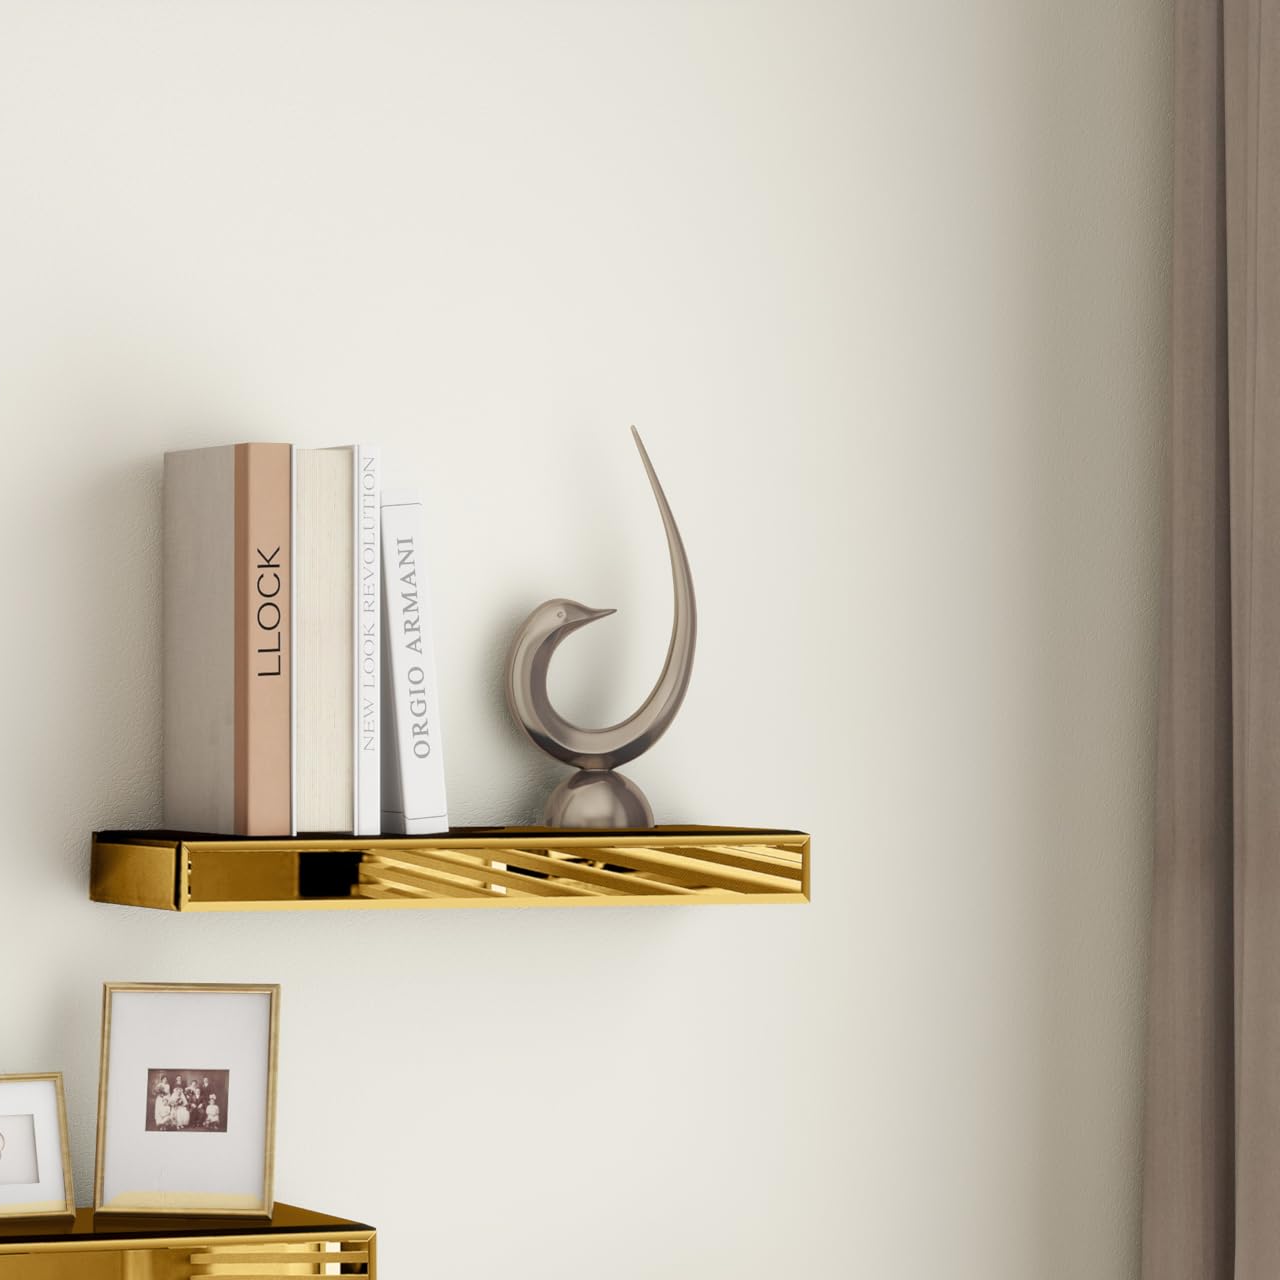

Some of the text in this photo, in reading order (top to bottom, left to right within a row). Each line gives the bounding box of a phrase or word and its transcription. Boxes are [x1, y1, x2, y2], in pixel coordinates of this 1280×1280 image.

[256, 546, 281, 677] LLOCK
[363, 456, 376, 752] NEW LOOK REVOLUTION
[396, 536, 431, 759] ORGIO ARMANI
